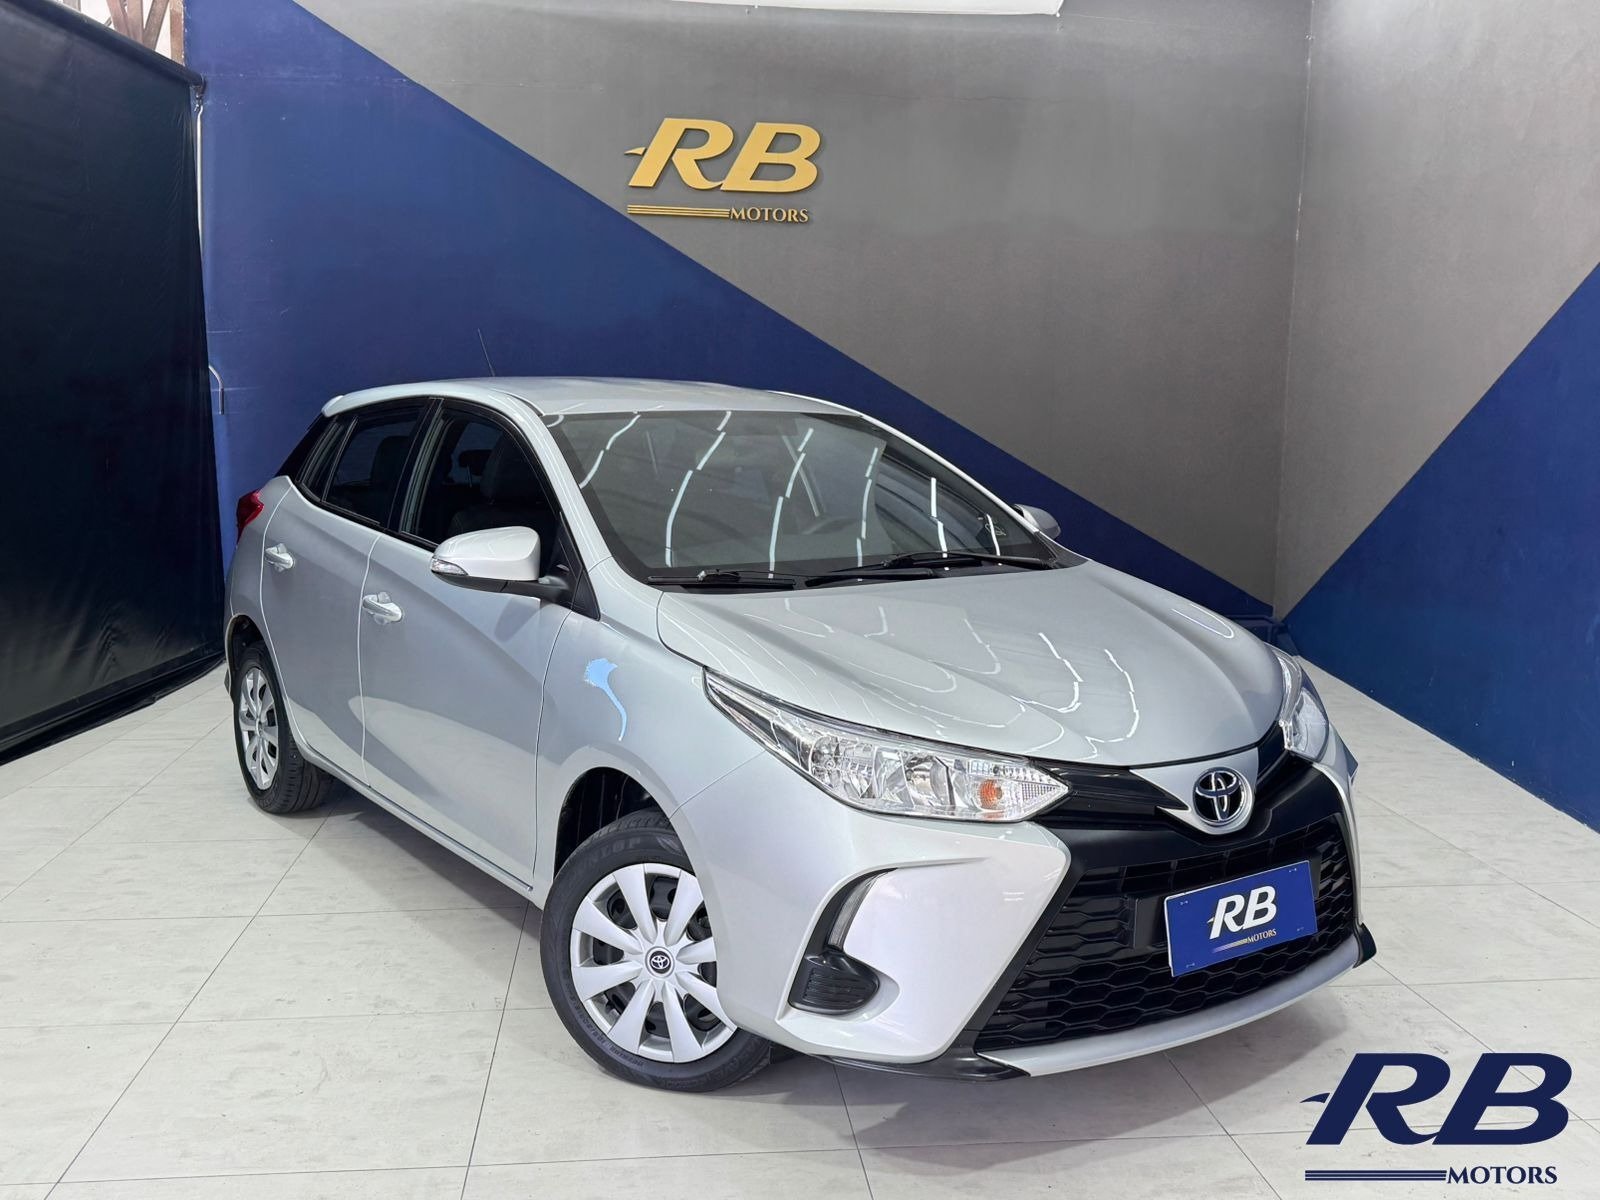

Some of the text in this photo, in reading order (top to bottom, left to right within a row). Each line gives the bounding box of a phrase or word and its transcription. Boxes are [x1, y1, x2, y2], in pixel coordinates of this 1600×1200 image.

[626, 117, 821, 193] RB
[729, 206, 809, 223] MOTORS
[1208, 885, 1277, 940] RB
[1247, 928, 1277, 944] MOTORS
